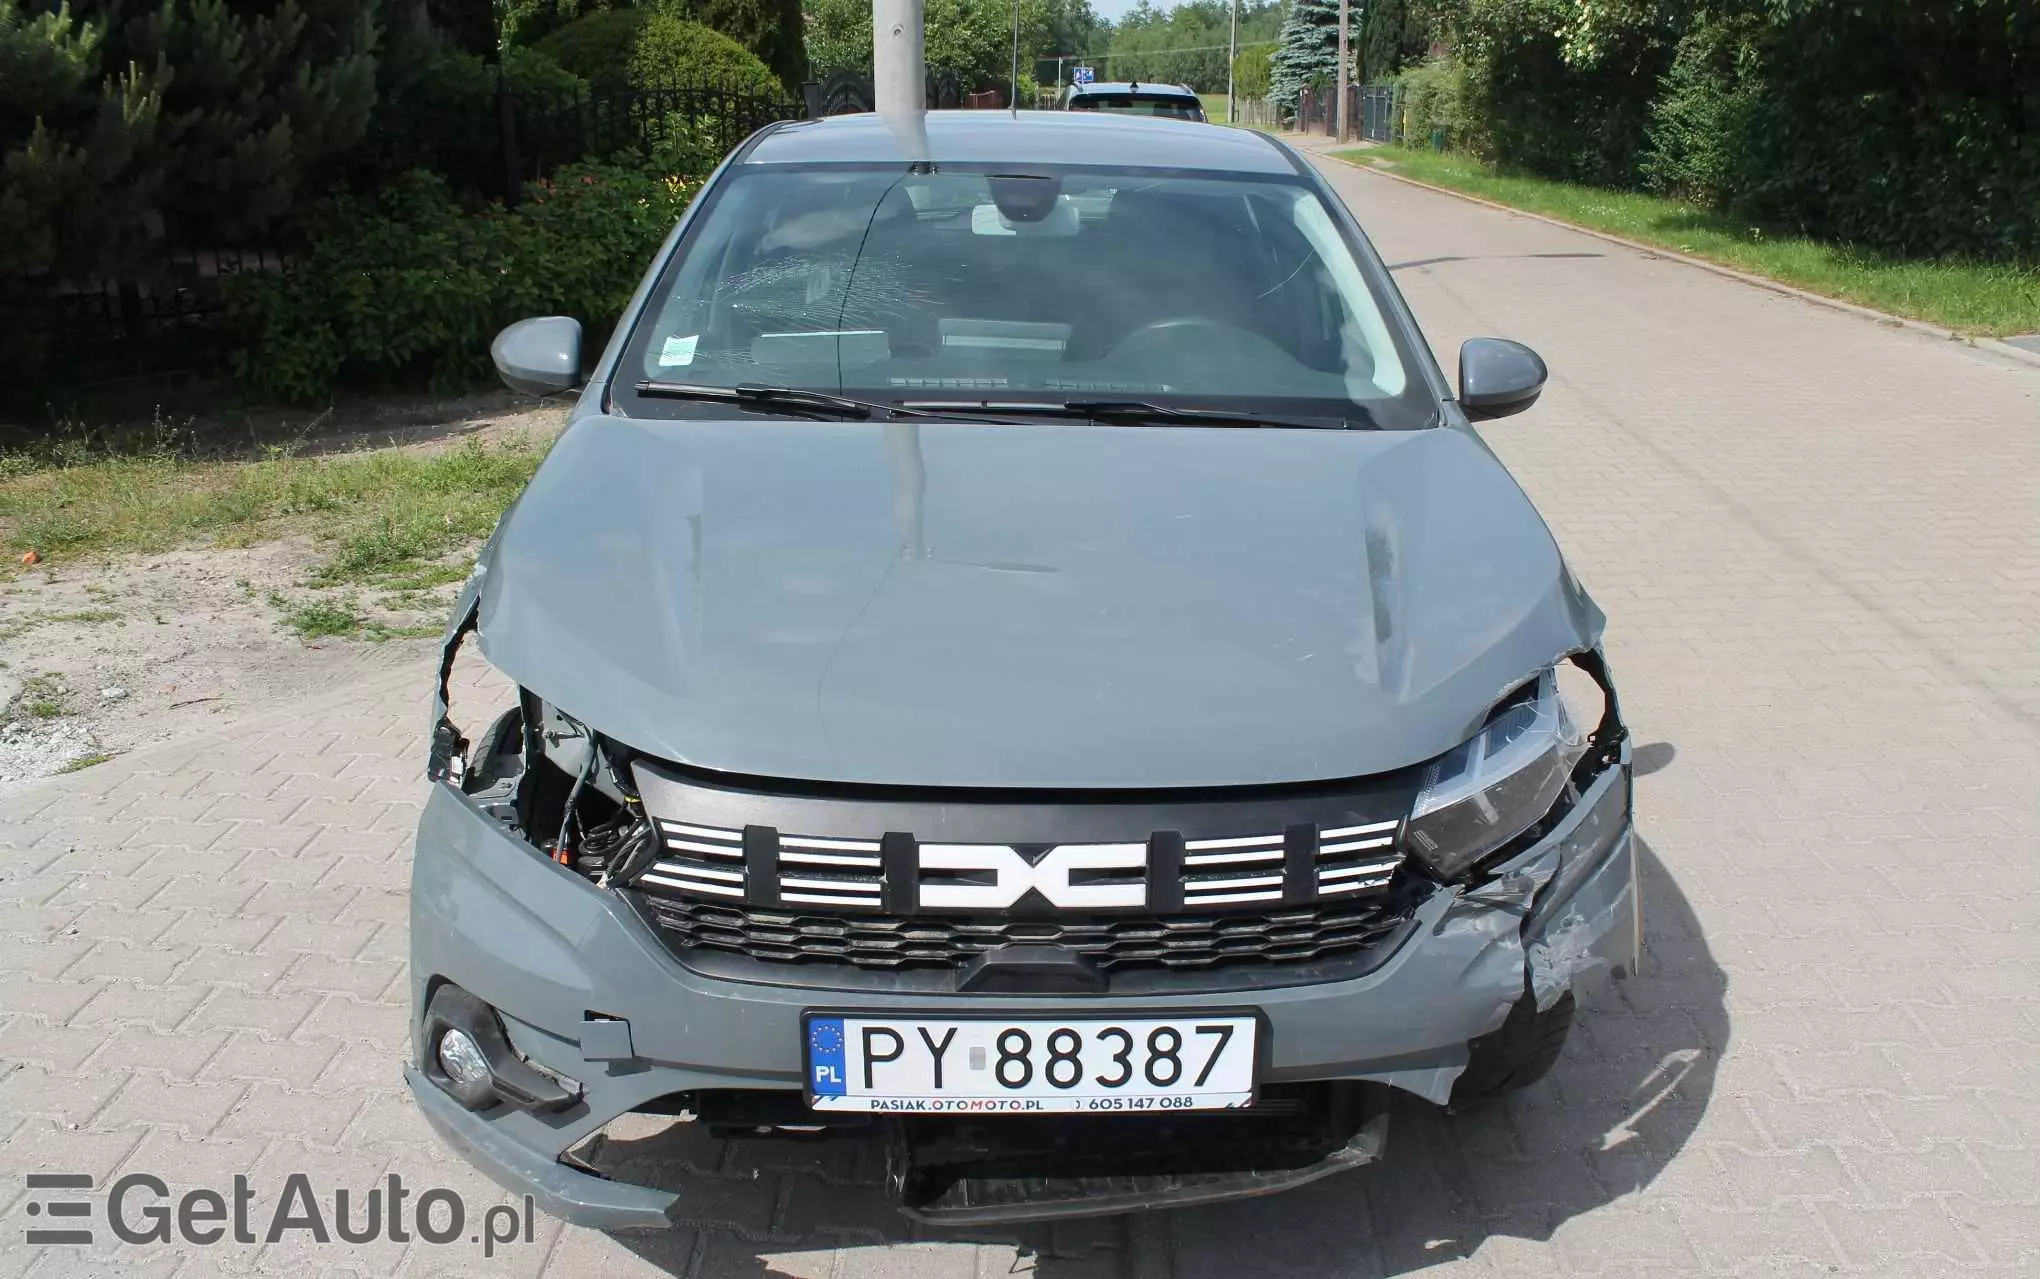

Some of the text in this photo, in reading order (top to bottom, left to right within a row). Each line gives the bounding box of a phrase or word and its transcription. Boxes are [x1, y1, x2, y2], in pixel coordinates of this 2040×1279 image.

[861, 1025, 1234, 1089] PY 88387
[815, 1065, 842, 1083] PL
[870, 1096, 1193, 1111] PASIAK.OTOMOTO.PL 605 147 088
